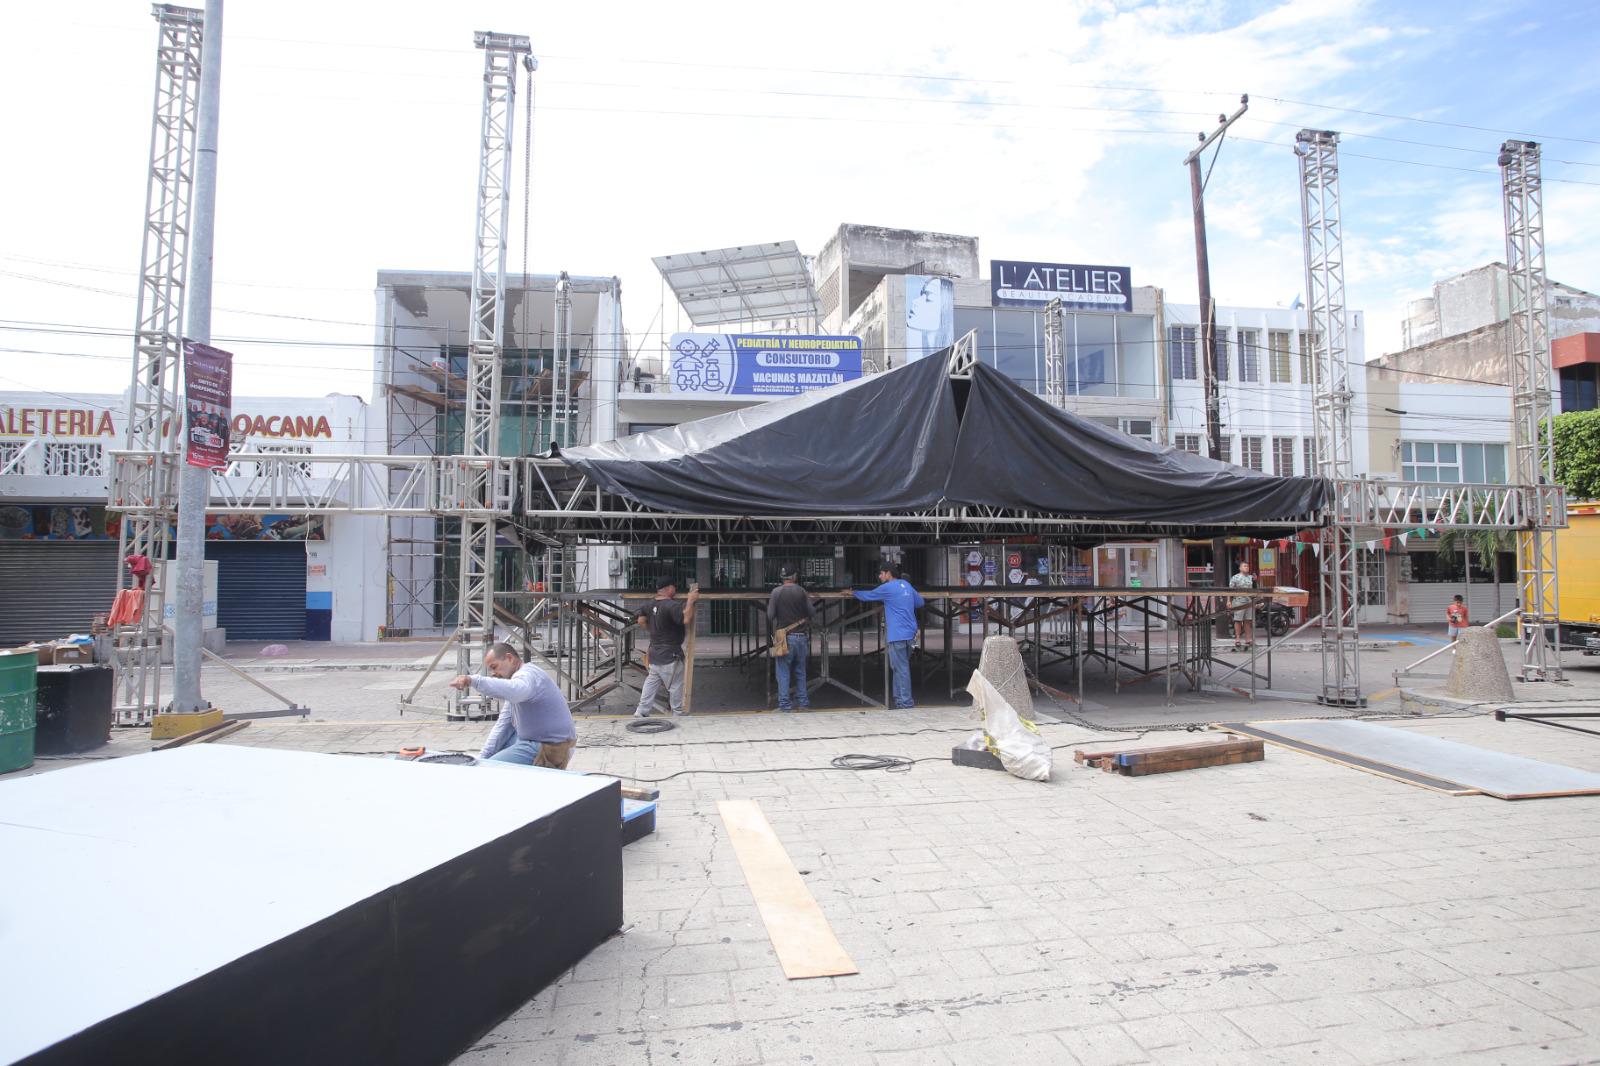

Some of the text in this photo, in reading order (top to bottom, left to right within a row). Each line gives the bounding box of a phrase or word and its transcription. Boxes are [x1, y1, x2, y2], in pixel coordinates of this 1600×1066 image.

[1023, 267, 1122, 292] ATELIER
[782, 338, 787, 348] Y
[765, 353, 831, 365] CONSULTORIO
[752, 371, 844, 384] VACUNAS MAZATLÁN
